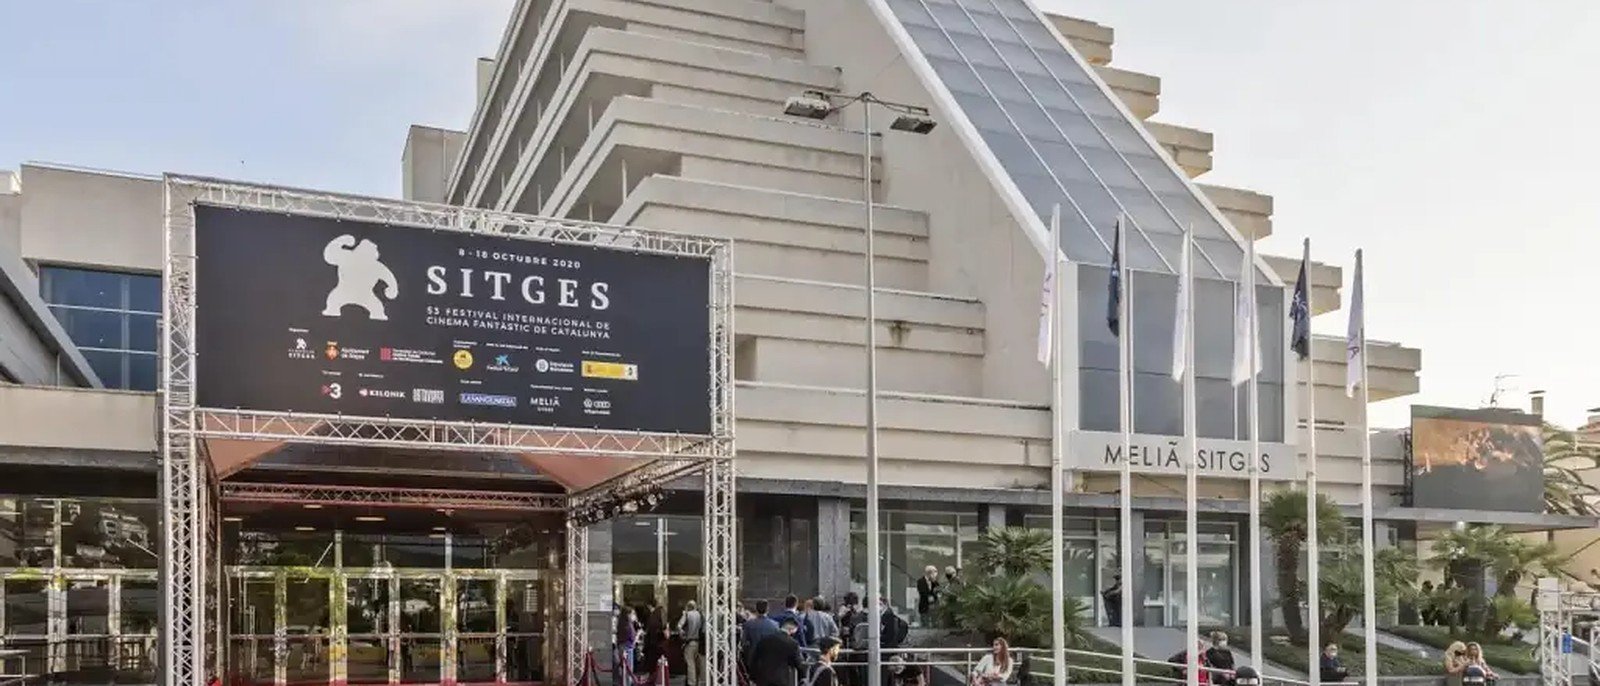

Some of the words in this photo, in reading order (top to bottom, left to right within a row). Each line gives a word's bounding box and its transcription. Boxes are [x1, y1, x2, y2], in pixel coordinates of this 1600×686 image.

[492, 251, 548, 266] OCTUBRE
[552, 258, 581, 269] 2020
[426, 265, 610, 311] SITGES
[426, 305, 440, 316] 53
[445, 307, 498, 321] FESTIVAL
[502, 313, 592, 330] INTERNACIONAL
[595, 321, 610, 331] DE
[426, 315, 470, 328] CINEMA
[533, 325, 548, 335] DE
[550, 326, 611, 340] CATALUNYA
